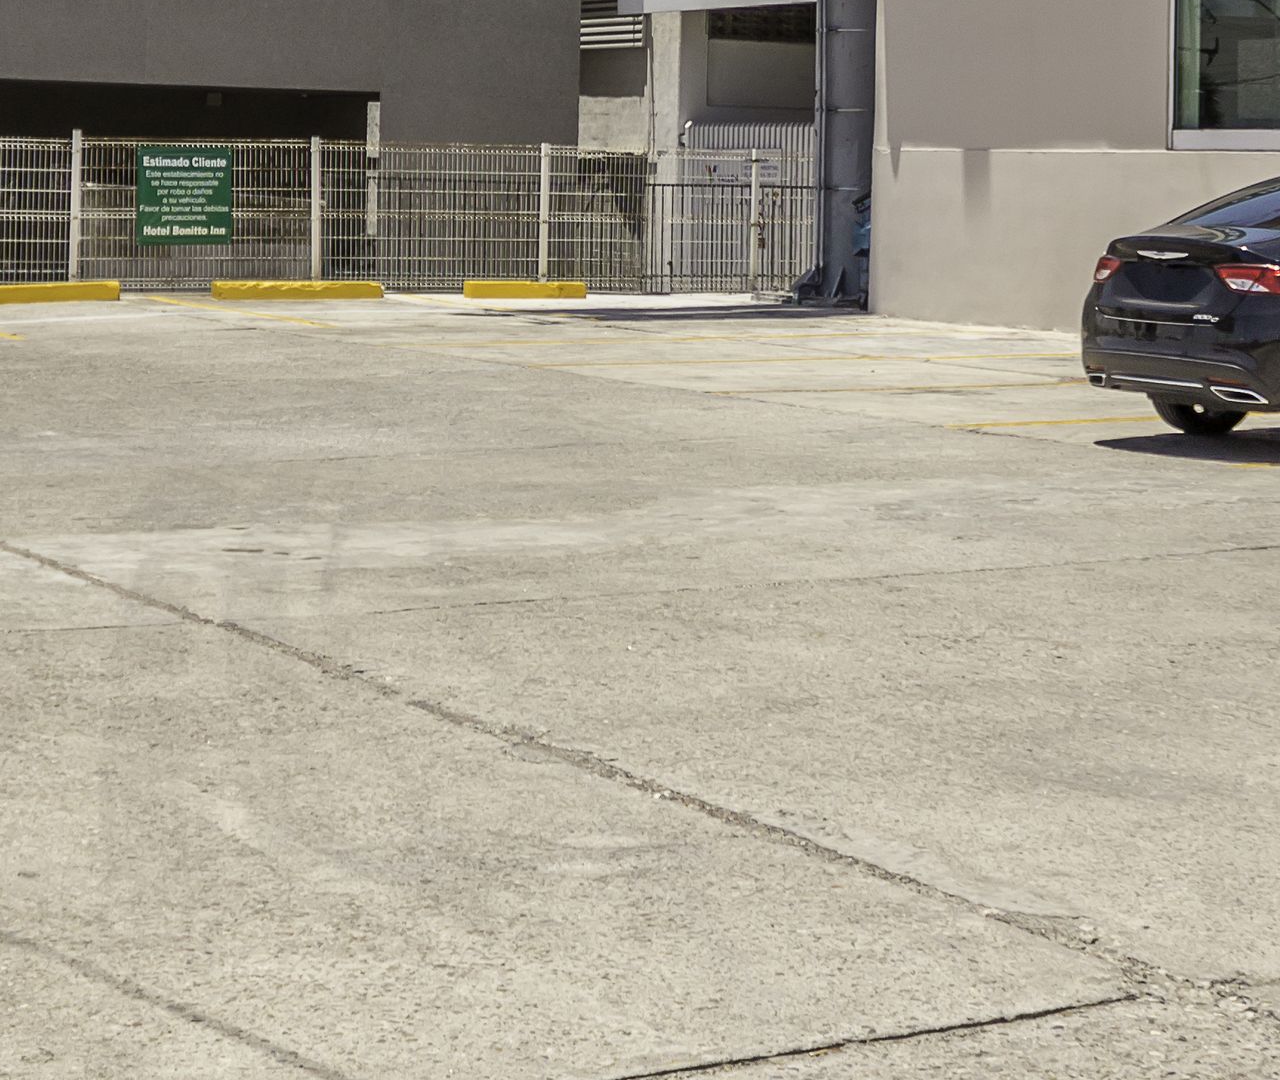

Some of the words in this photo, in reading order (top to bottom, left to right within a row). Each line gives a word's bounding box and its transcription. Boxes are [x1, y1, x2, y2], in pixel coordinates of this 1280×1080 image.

[143, 156, 190, 167] Estimado
[192, 157, 227, 168] Cliente
[143, 225, 170, 236] Hotel
[172, 225, 208, 236] Bonitto
[210, 225, 226, 235] Inn
